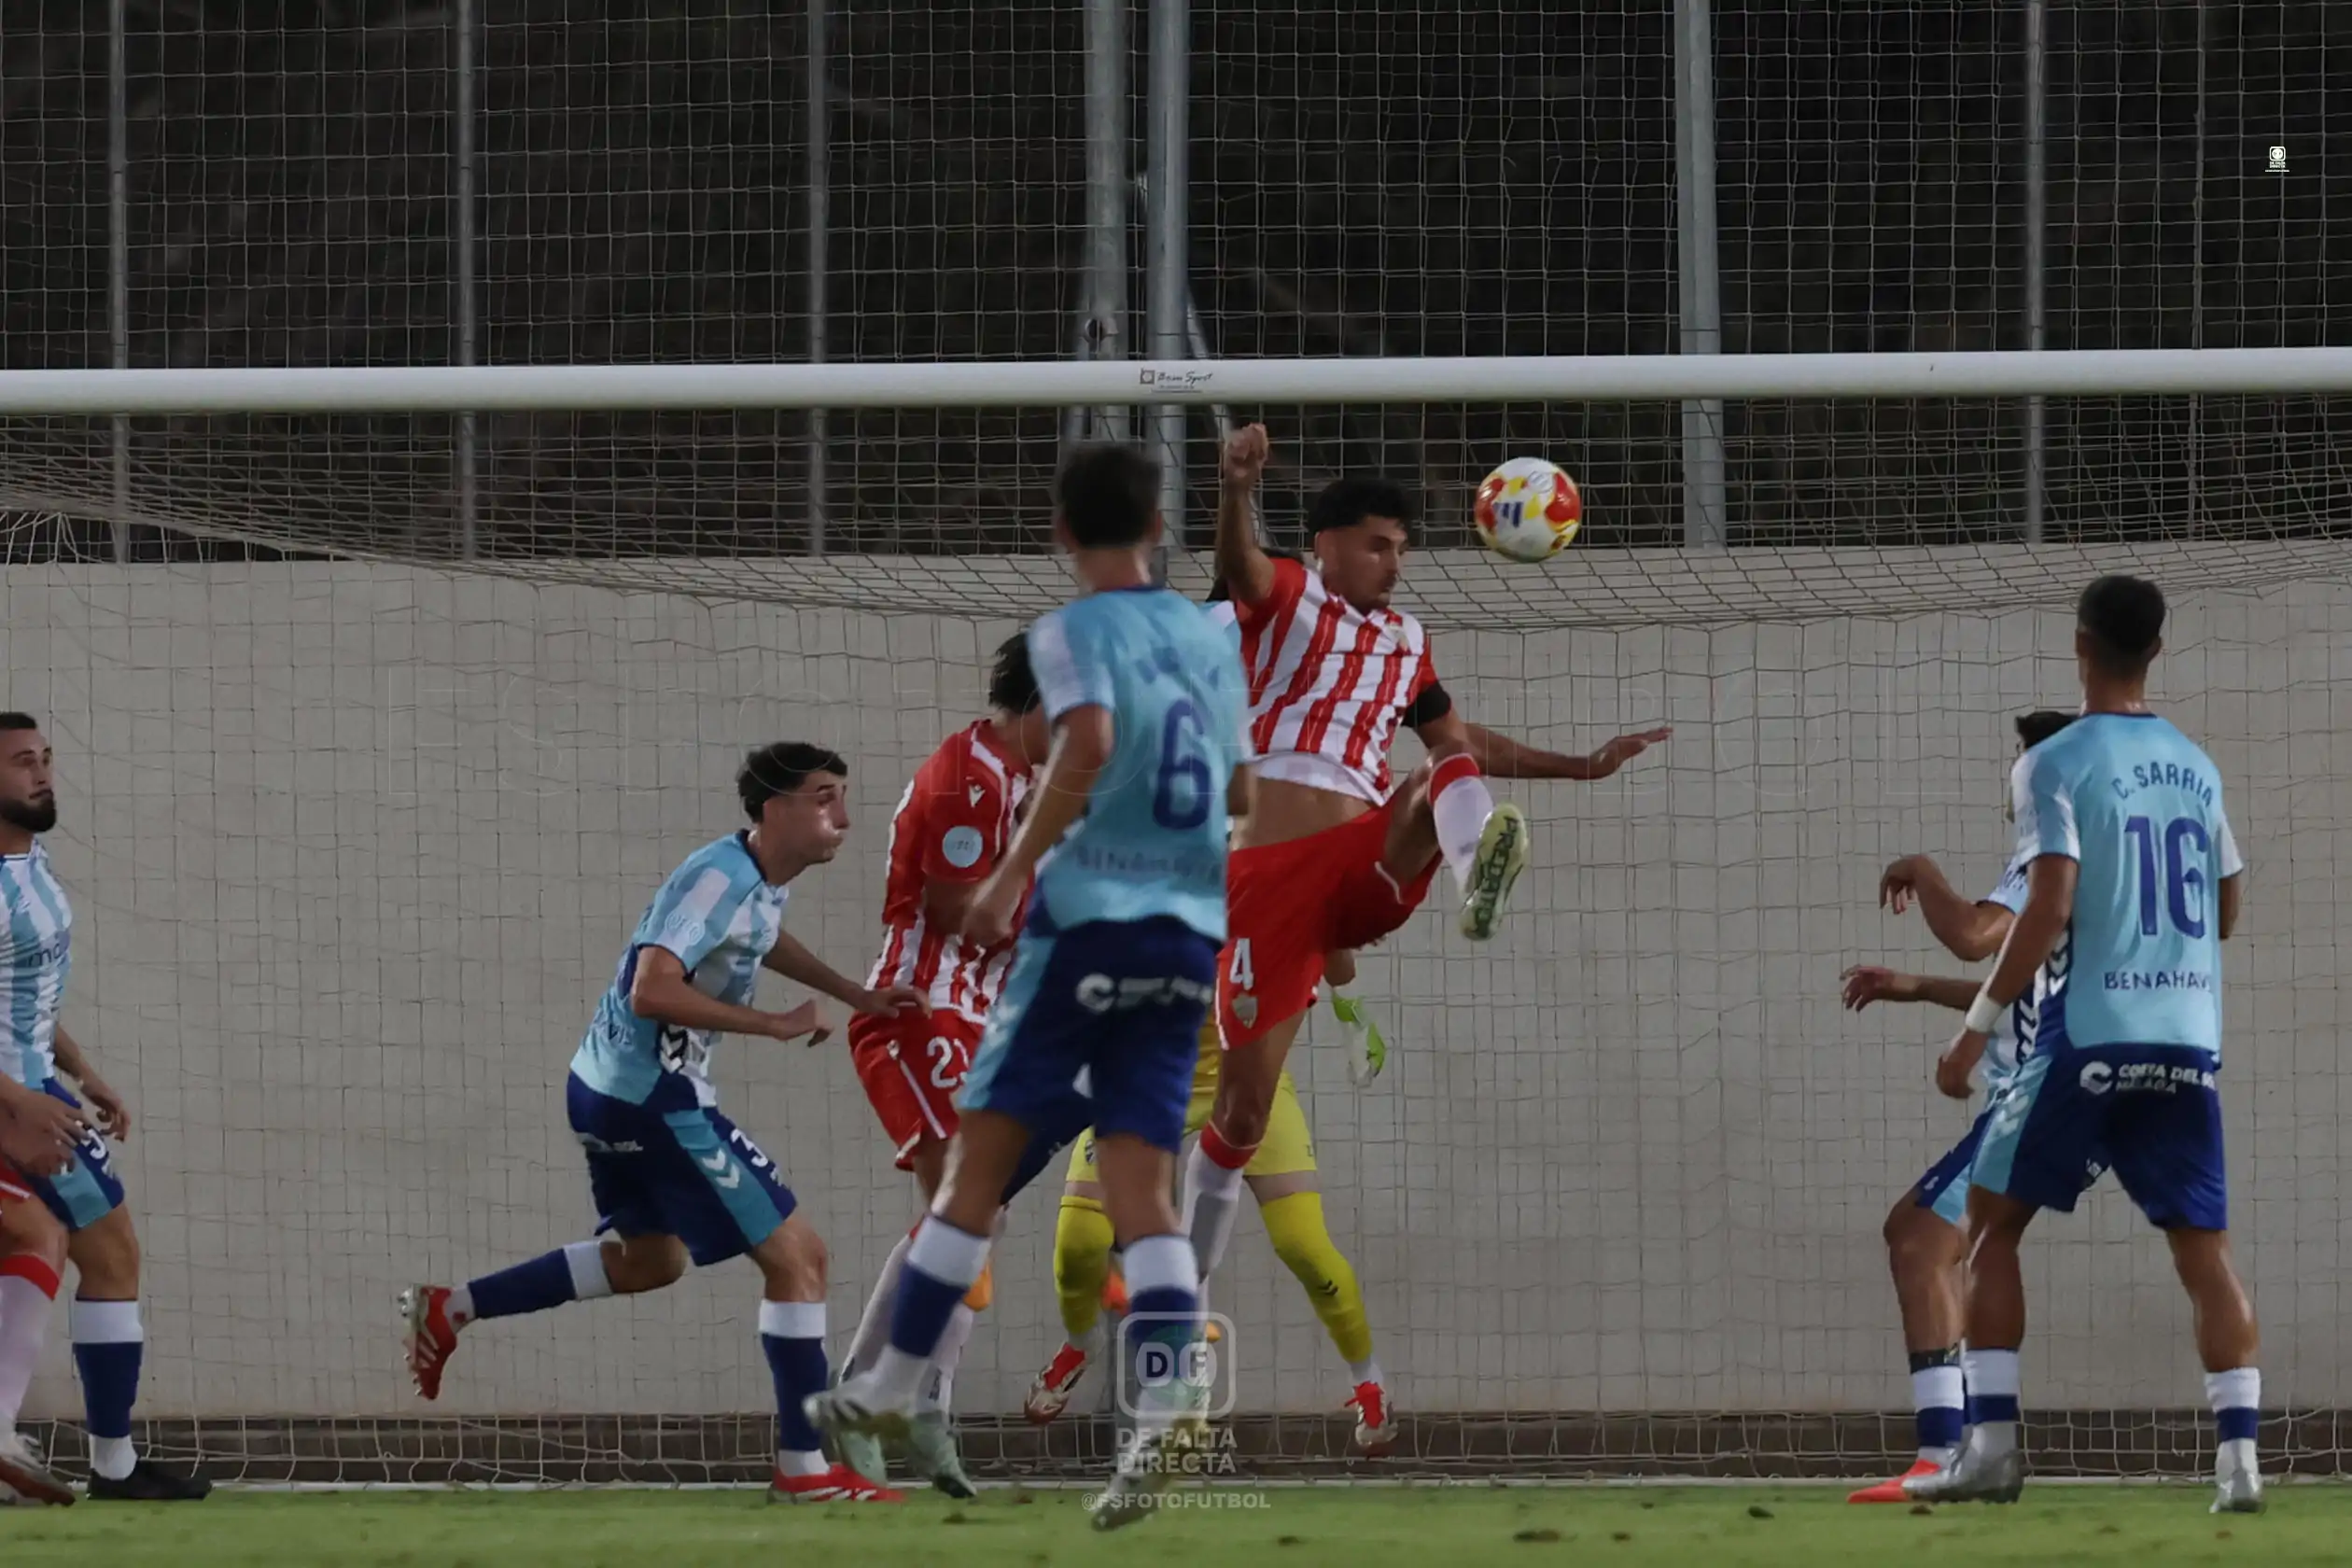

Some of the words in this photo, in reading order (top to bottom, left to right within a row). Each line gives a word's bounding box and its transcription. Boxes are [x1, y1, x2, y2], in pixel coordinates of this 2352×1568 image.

[1153, 698, 1211, 830] 6
[2124, 815, 2210, 940] 16
[1229, 937, 1254, 991] 4
